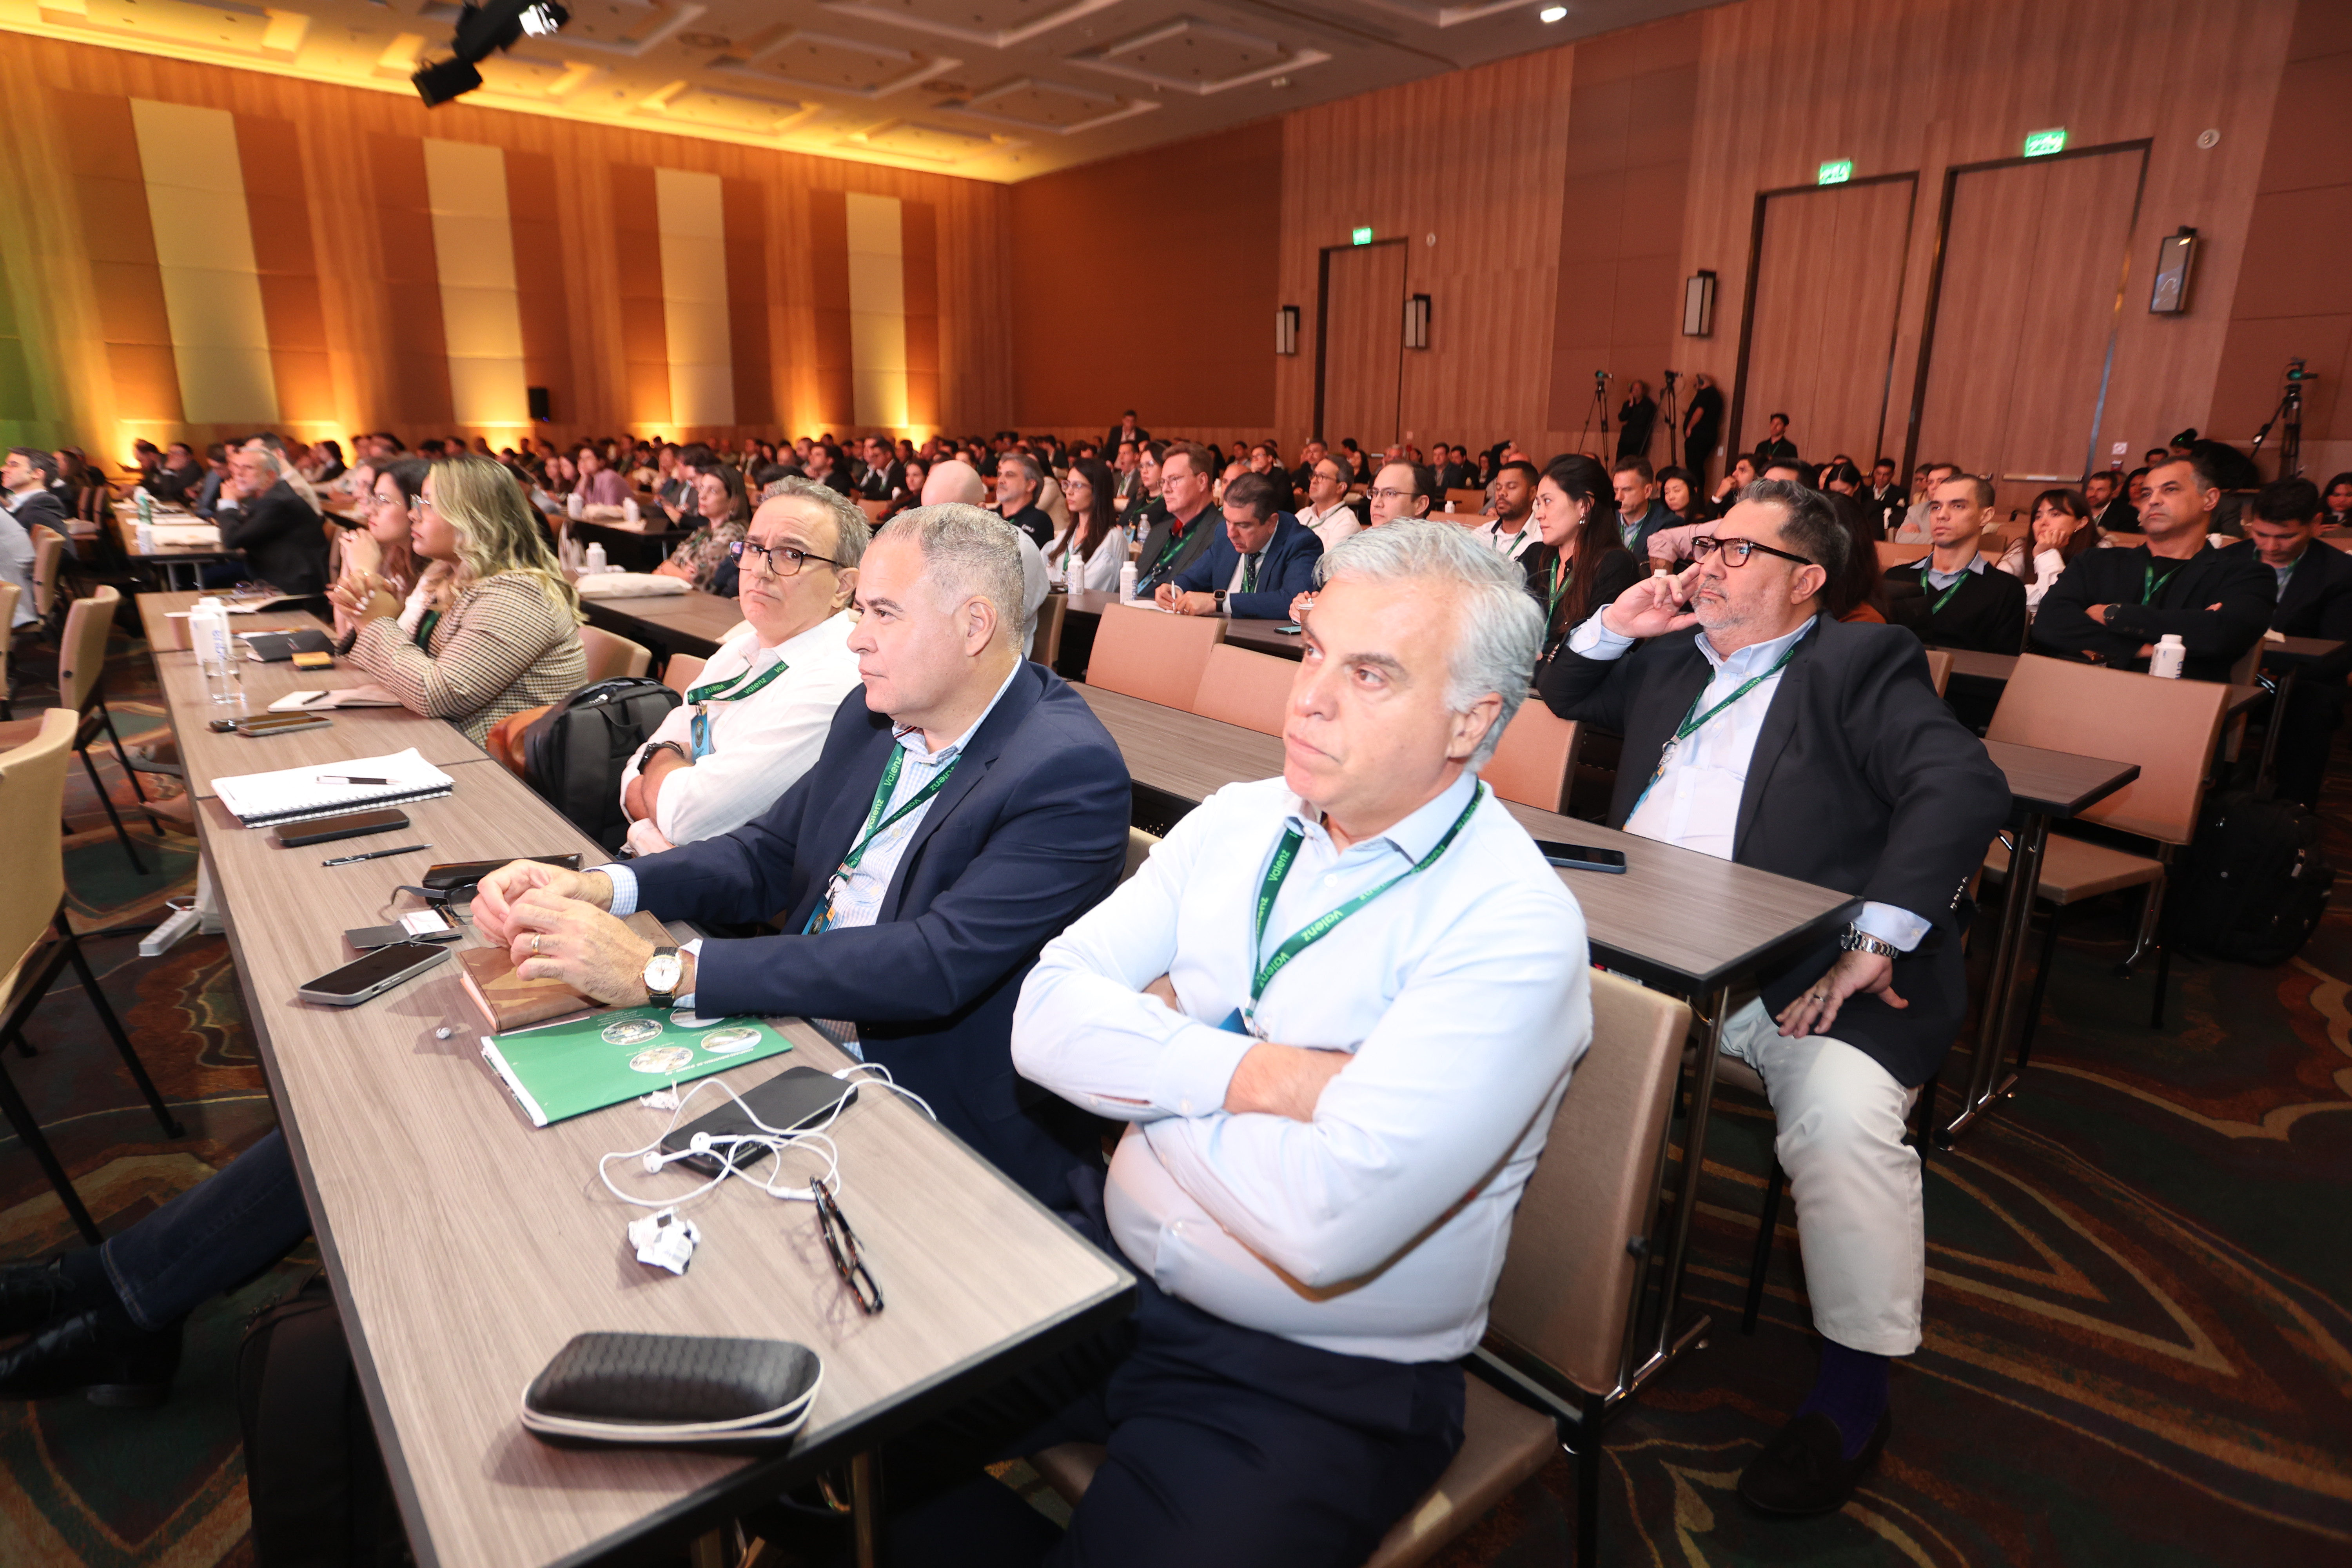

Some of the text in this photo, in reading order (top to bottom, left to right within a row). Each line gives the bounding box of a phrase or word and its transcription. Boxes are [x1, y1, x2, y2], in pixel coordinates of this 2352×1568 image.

[774, 662, 787, 673] Val
[704, 684, 726, 694] Valenz
[744, 677, 767, 694] Valenz
[1738, 677, 1762, 695] Valenz
[1708, 701, 1730, 718] Valenz
[1679, 723, 1700, 739] Valenz
[884, 756, 902, 786] Valenz
[867, 799, 884, 830] Valenz
[892, 799, 921, 819] Valenz
[1268, 849, 1290, 882] Valenz
[1301, 910, 1344, 942] Valenz
[1259, 952, 1291, 988] Valenz
